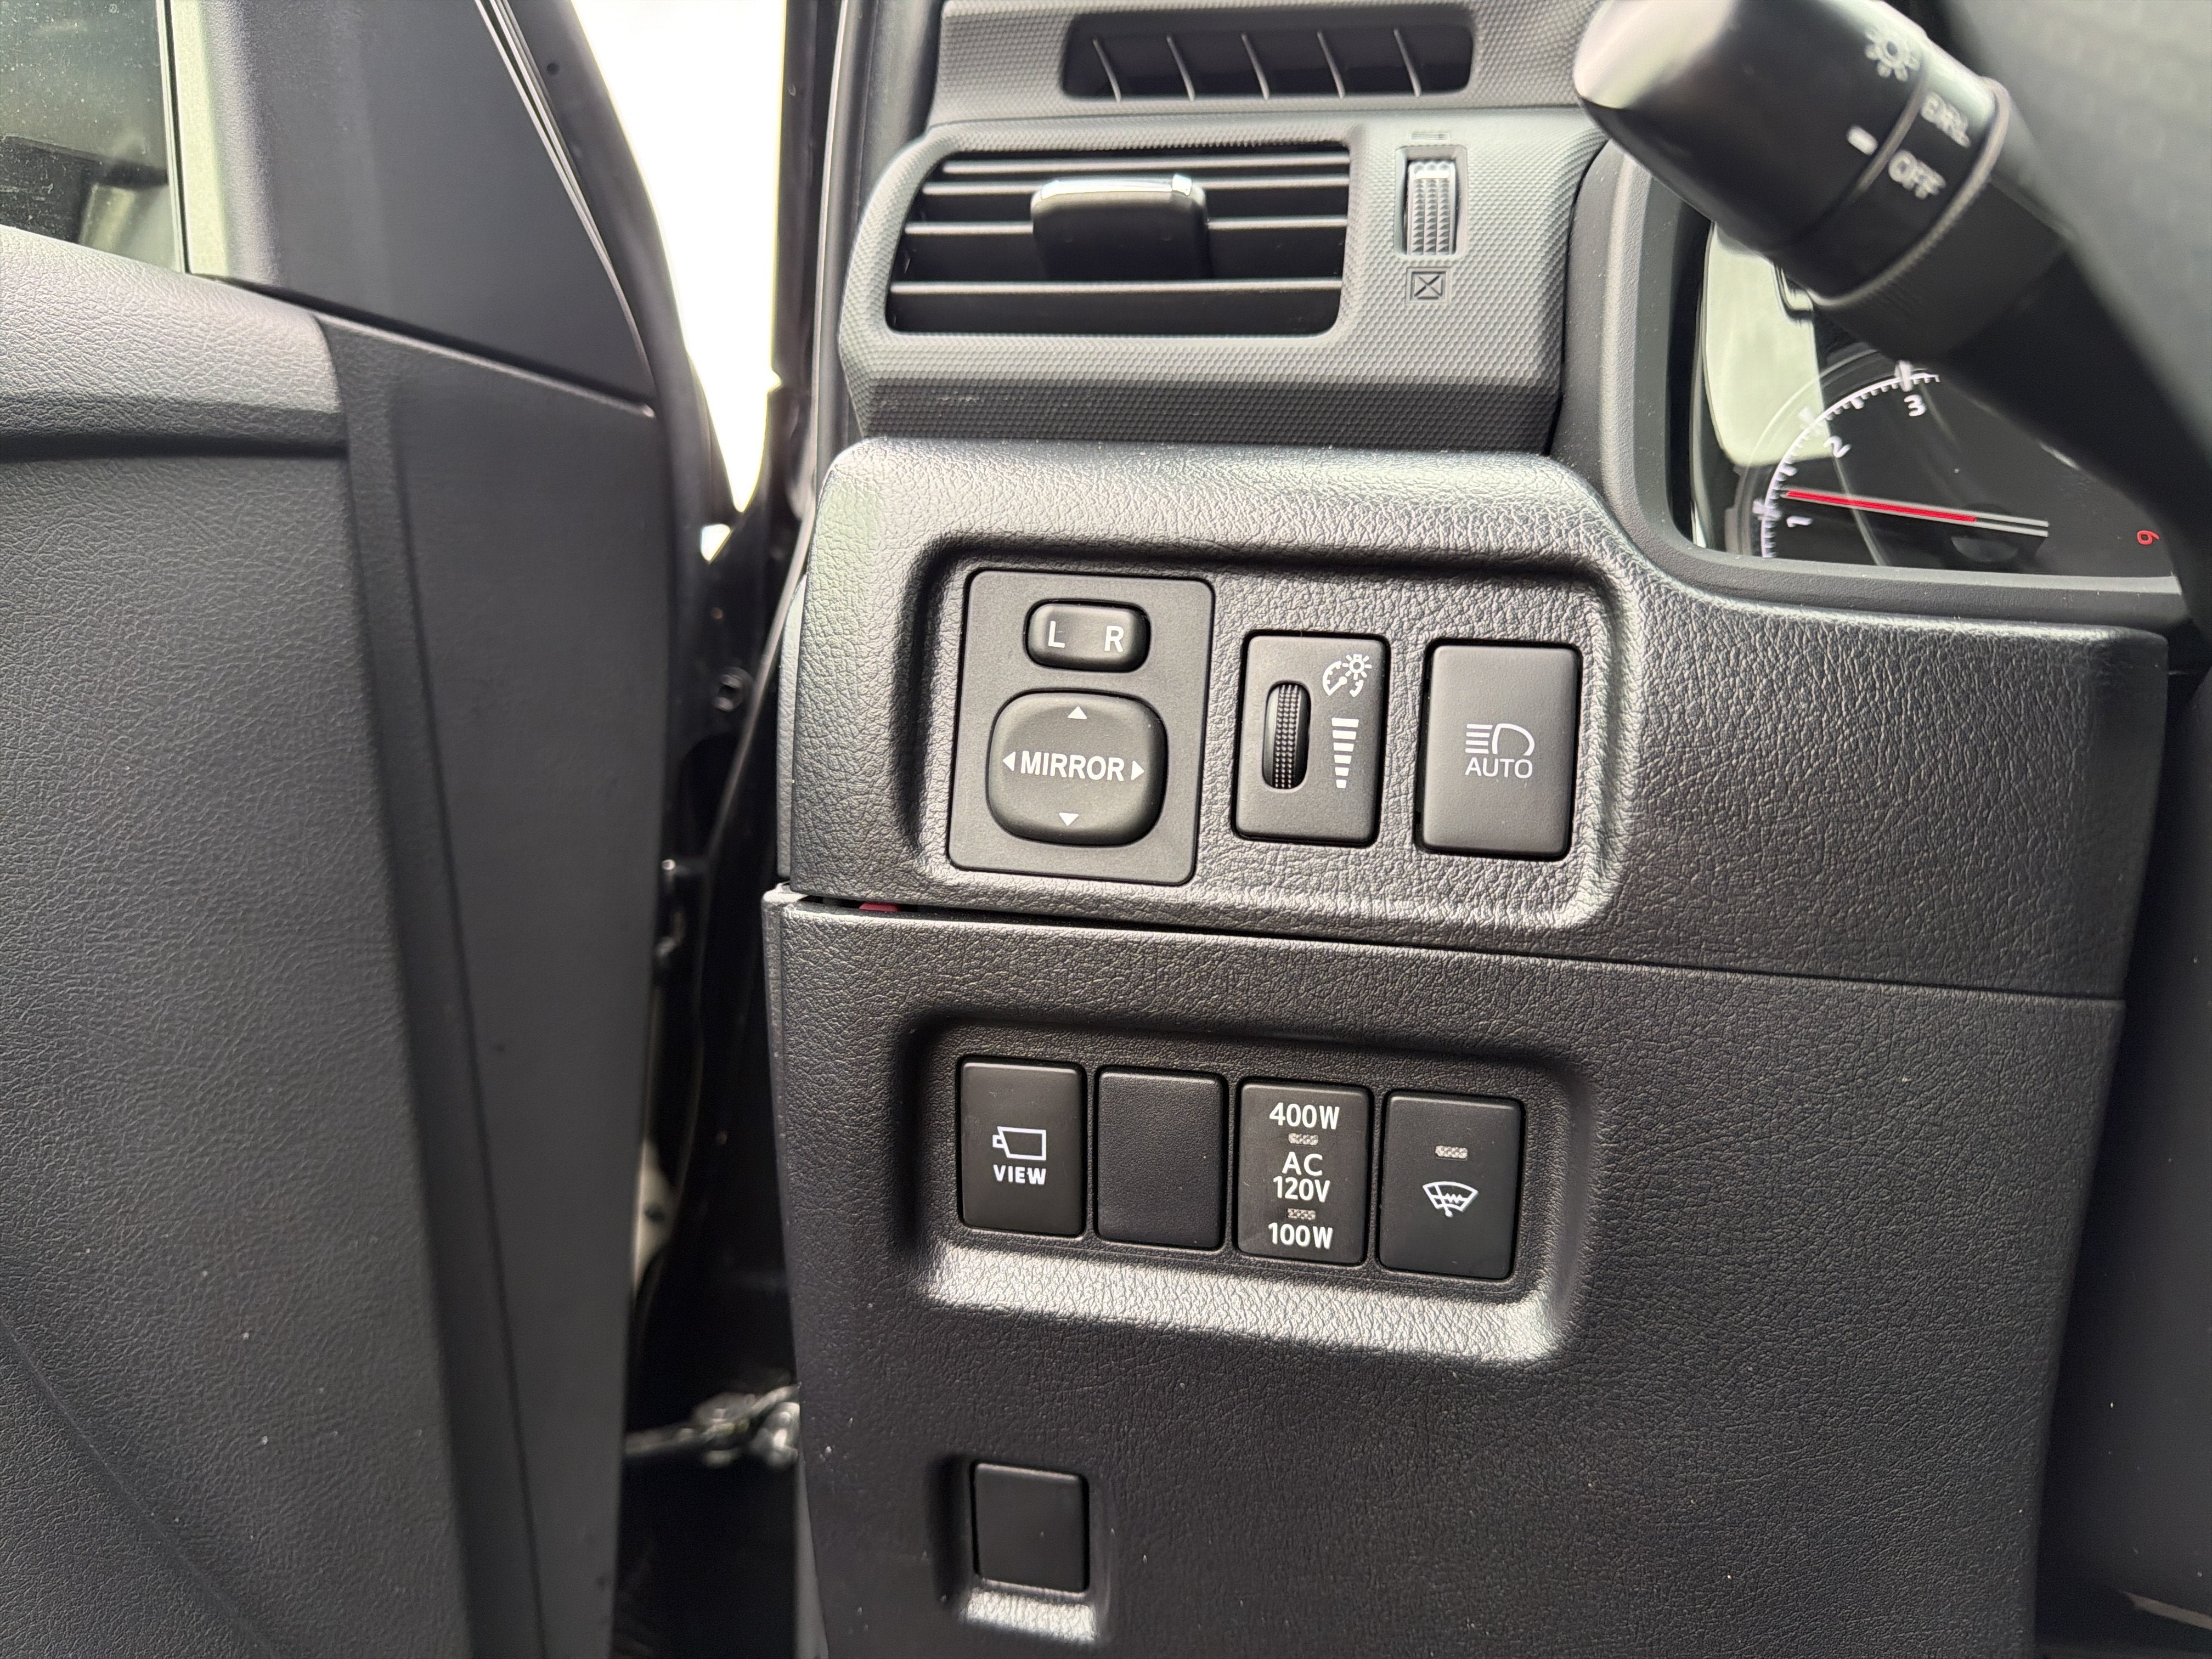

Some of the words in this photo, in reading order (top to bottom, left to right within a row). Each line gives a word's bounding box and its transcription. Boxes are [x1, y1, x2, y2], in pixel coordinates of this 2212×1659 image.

[1888, 149, 1946, 200] OFF
[1904, 394, 1926, 417] 3
[1822, 435, 1852, 458] 2
[1786, 515, 1812, 528] 1
[2137, 530, 2159, 545] 6
[1048, 620, 1065, 649] L
[1103, 625, 1124, 653] R
[1020, 750, 1125, 782] MIRROR
[1464, 757, 1533, 779] AUTO
[1268, 1102, 1341, 1130] 400W
[992, 1164, 1047, 1186] VIEW
[1281, 1152, 1323, 1177] AC
[1272, 1176, 1331, 1203] 120V
[1267, 1221, 1334, 1250] 100W
